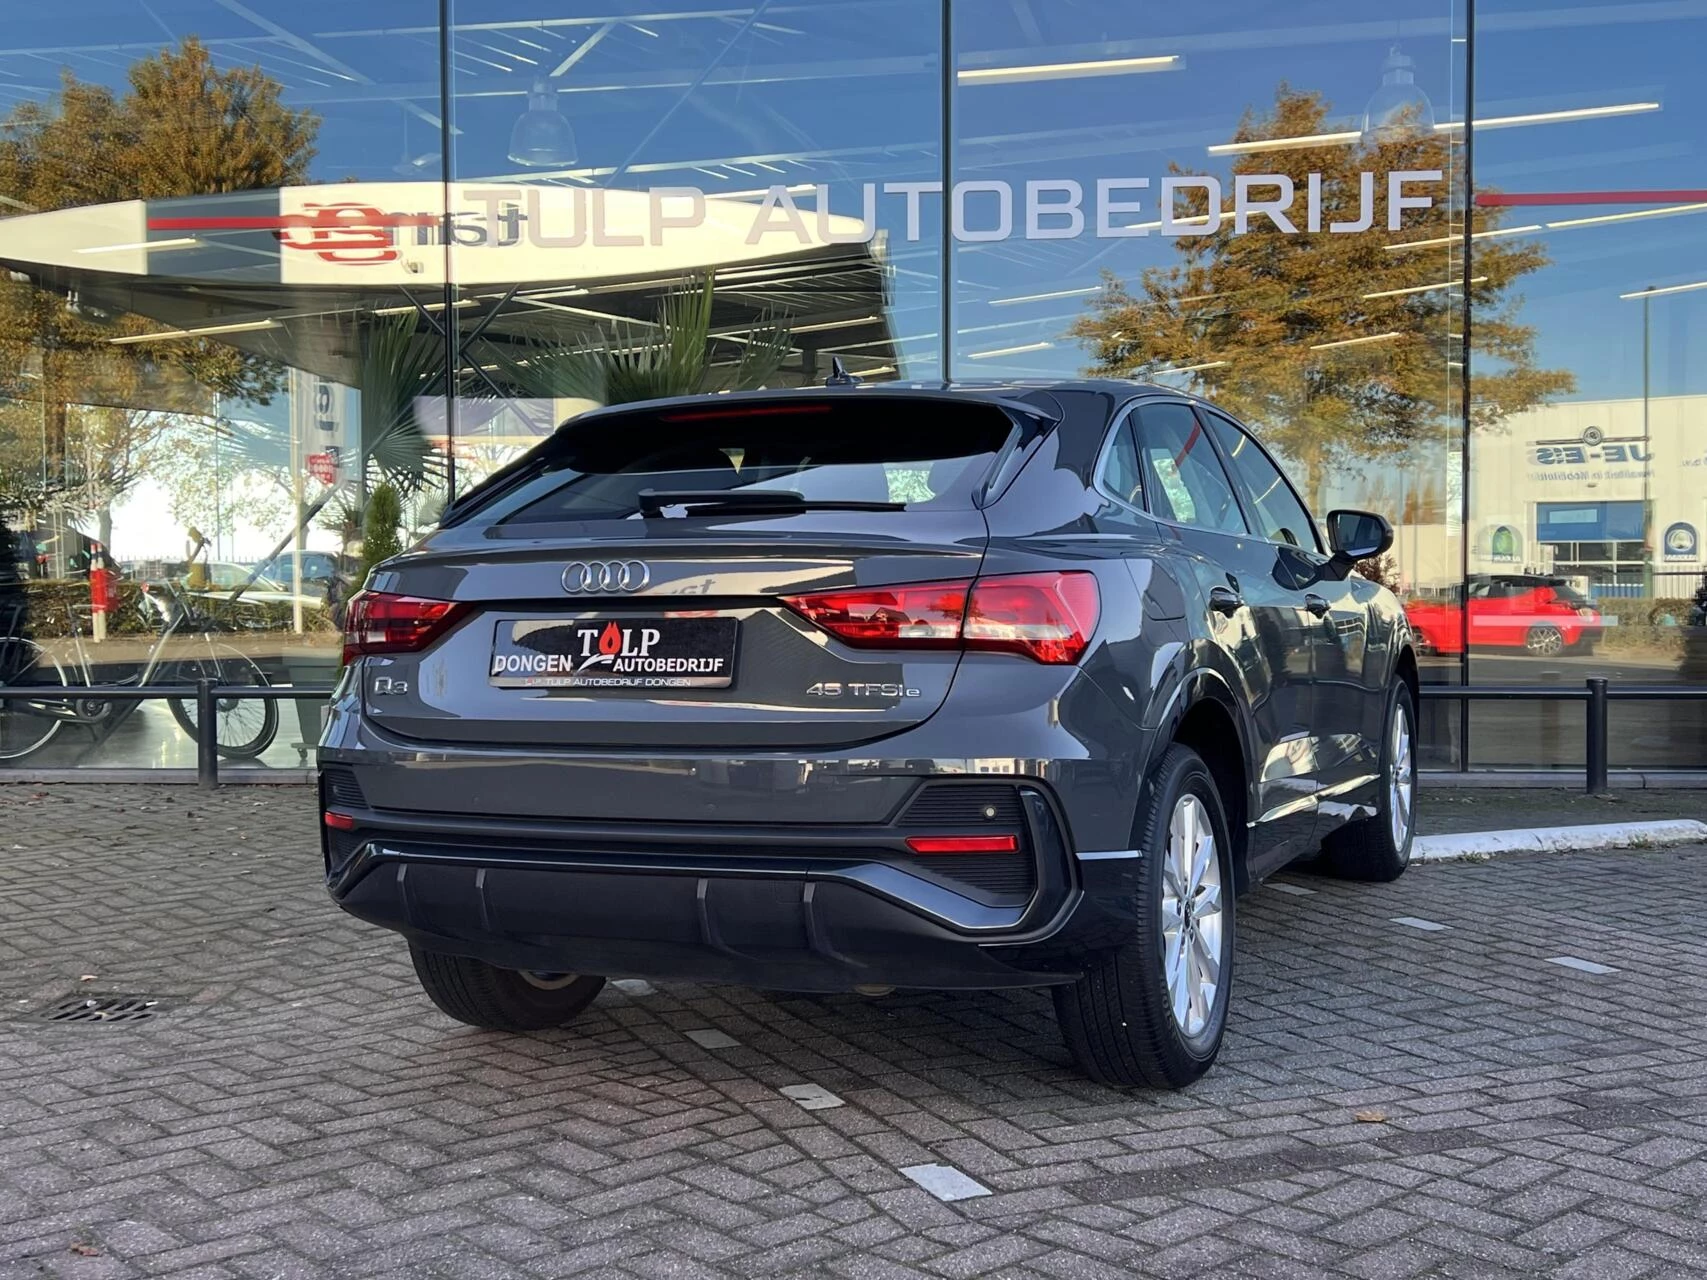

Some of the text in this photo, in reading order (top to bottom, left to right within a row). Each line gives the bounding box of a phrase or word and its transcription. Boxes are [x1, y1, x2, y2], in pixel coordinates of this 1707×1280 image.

[462, 169, 1443, 248] TULP AUTOBEDRIJF
[494, 654, 724, 672] DONGEN AUTOBEDRIJF
[374, 676, 408, 695] Q3
[806, 682, 842, 697] 45
